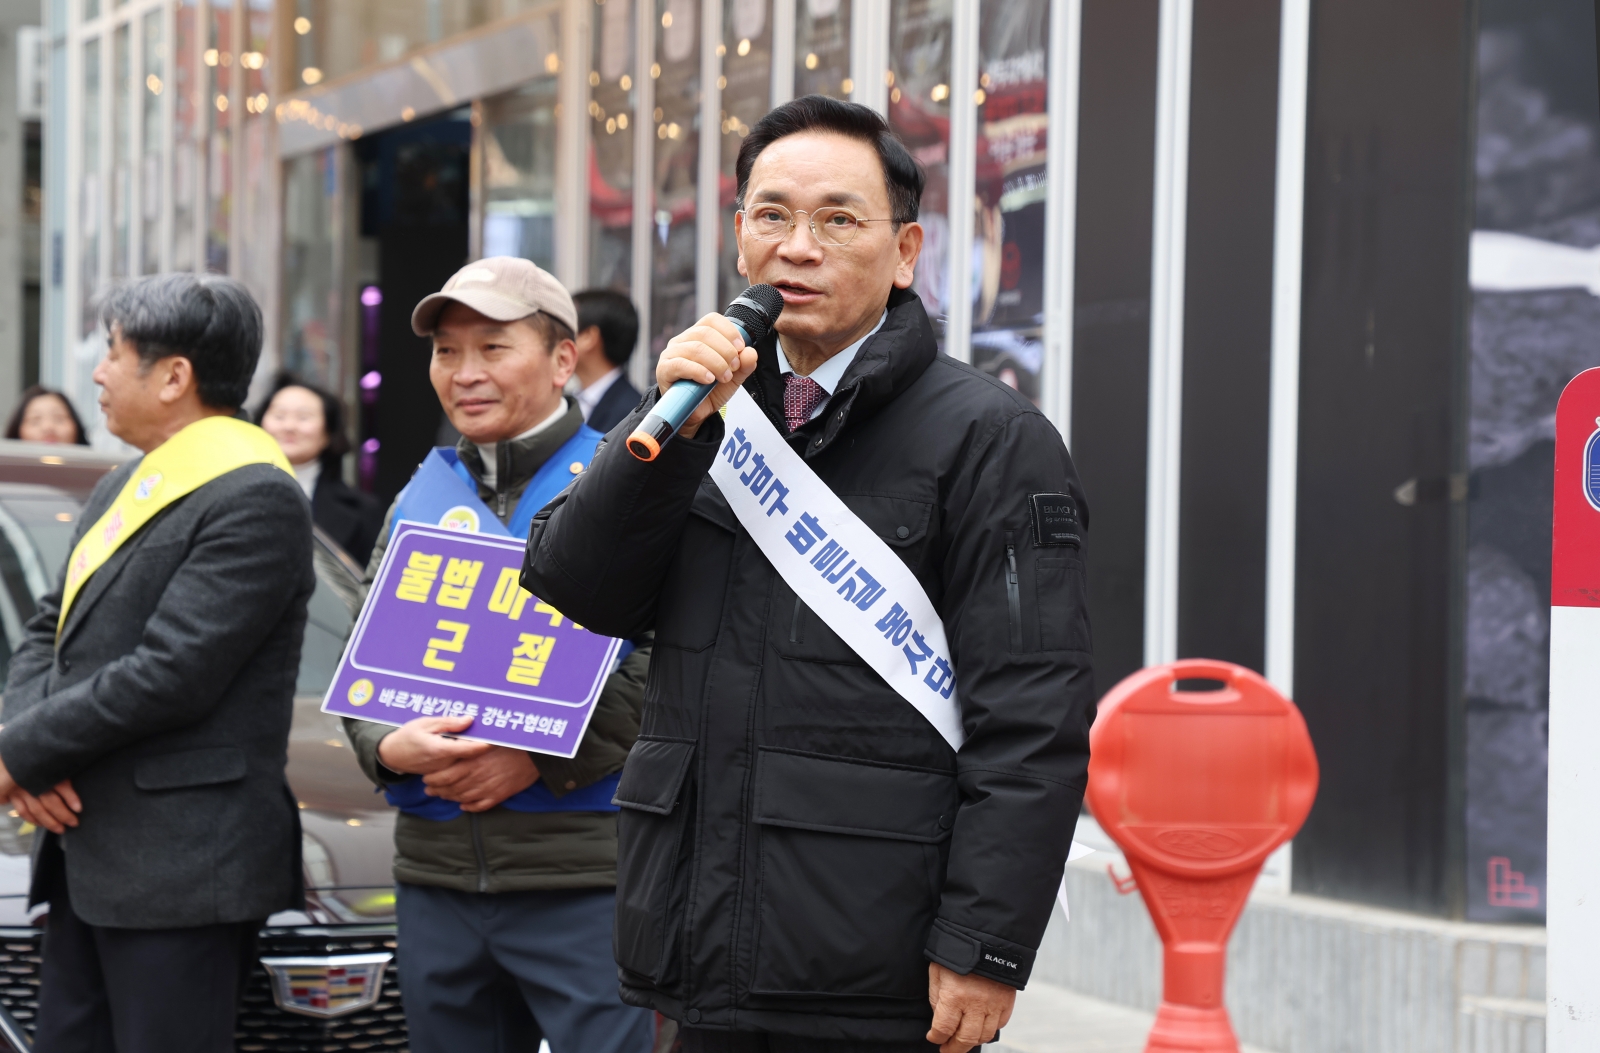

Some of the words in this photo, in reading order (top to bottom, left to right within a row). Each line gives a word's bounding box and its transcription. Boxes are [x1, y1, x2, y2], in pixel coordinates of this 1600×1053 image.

[395, 551, 484, 610] 불법
[722, 427, 790, 517] 강남구
[784, 511, 887, 612] 바른길
[875, 601, 957, 701] 봉사단
[378, 687, 479, 718] 바르게살기운동
[481, 706, 569, 738] 강남구협의회
